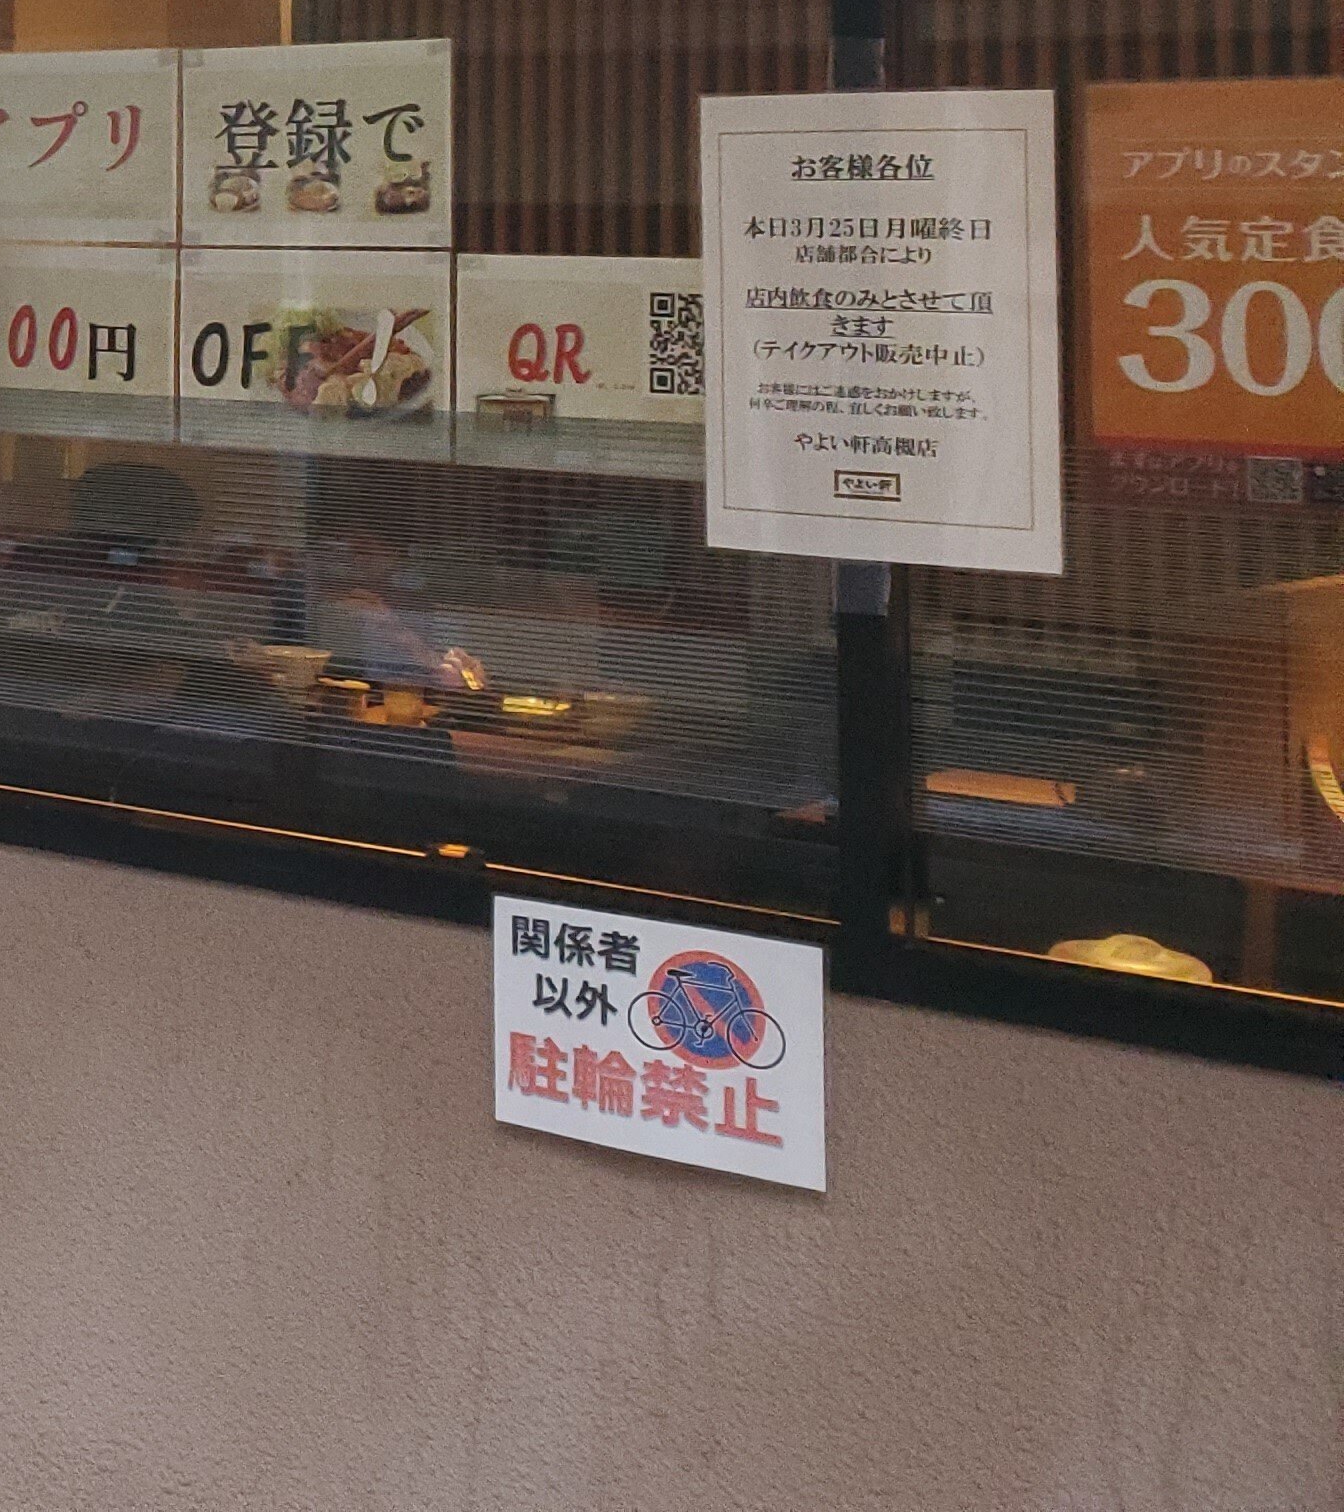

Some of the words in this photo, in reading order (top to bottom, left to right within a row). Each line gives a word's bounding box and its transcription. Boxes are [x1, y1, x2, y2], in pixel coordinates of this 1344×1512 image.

[214, 97, 426, 172] 登録で
[791, 153, 935, 181] お客様各位
[744, 215, 993, 241] 本日3月25日月曜終日
[794, 244, 933, 264] 店舗都合により
[745, 287, 994, 315] 店内飲食のみとさせて頂
[829, 314, 897, 339] きます
[1117, 278, 1344, 397] 30
[508, 322, 592, 385] QR
[793, 432, 941, 459] やよい軒高槻店
[841, 476, 894, 491] やよい軒
[511, 914, 641, 977] 関係者
[531, 973, 619, 1027] 以外
[507, 1030, 784, 1149] 駐輪禁止
